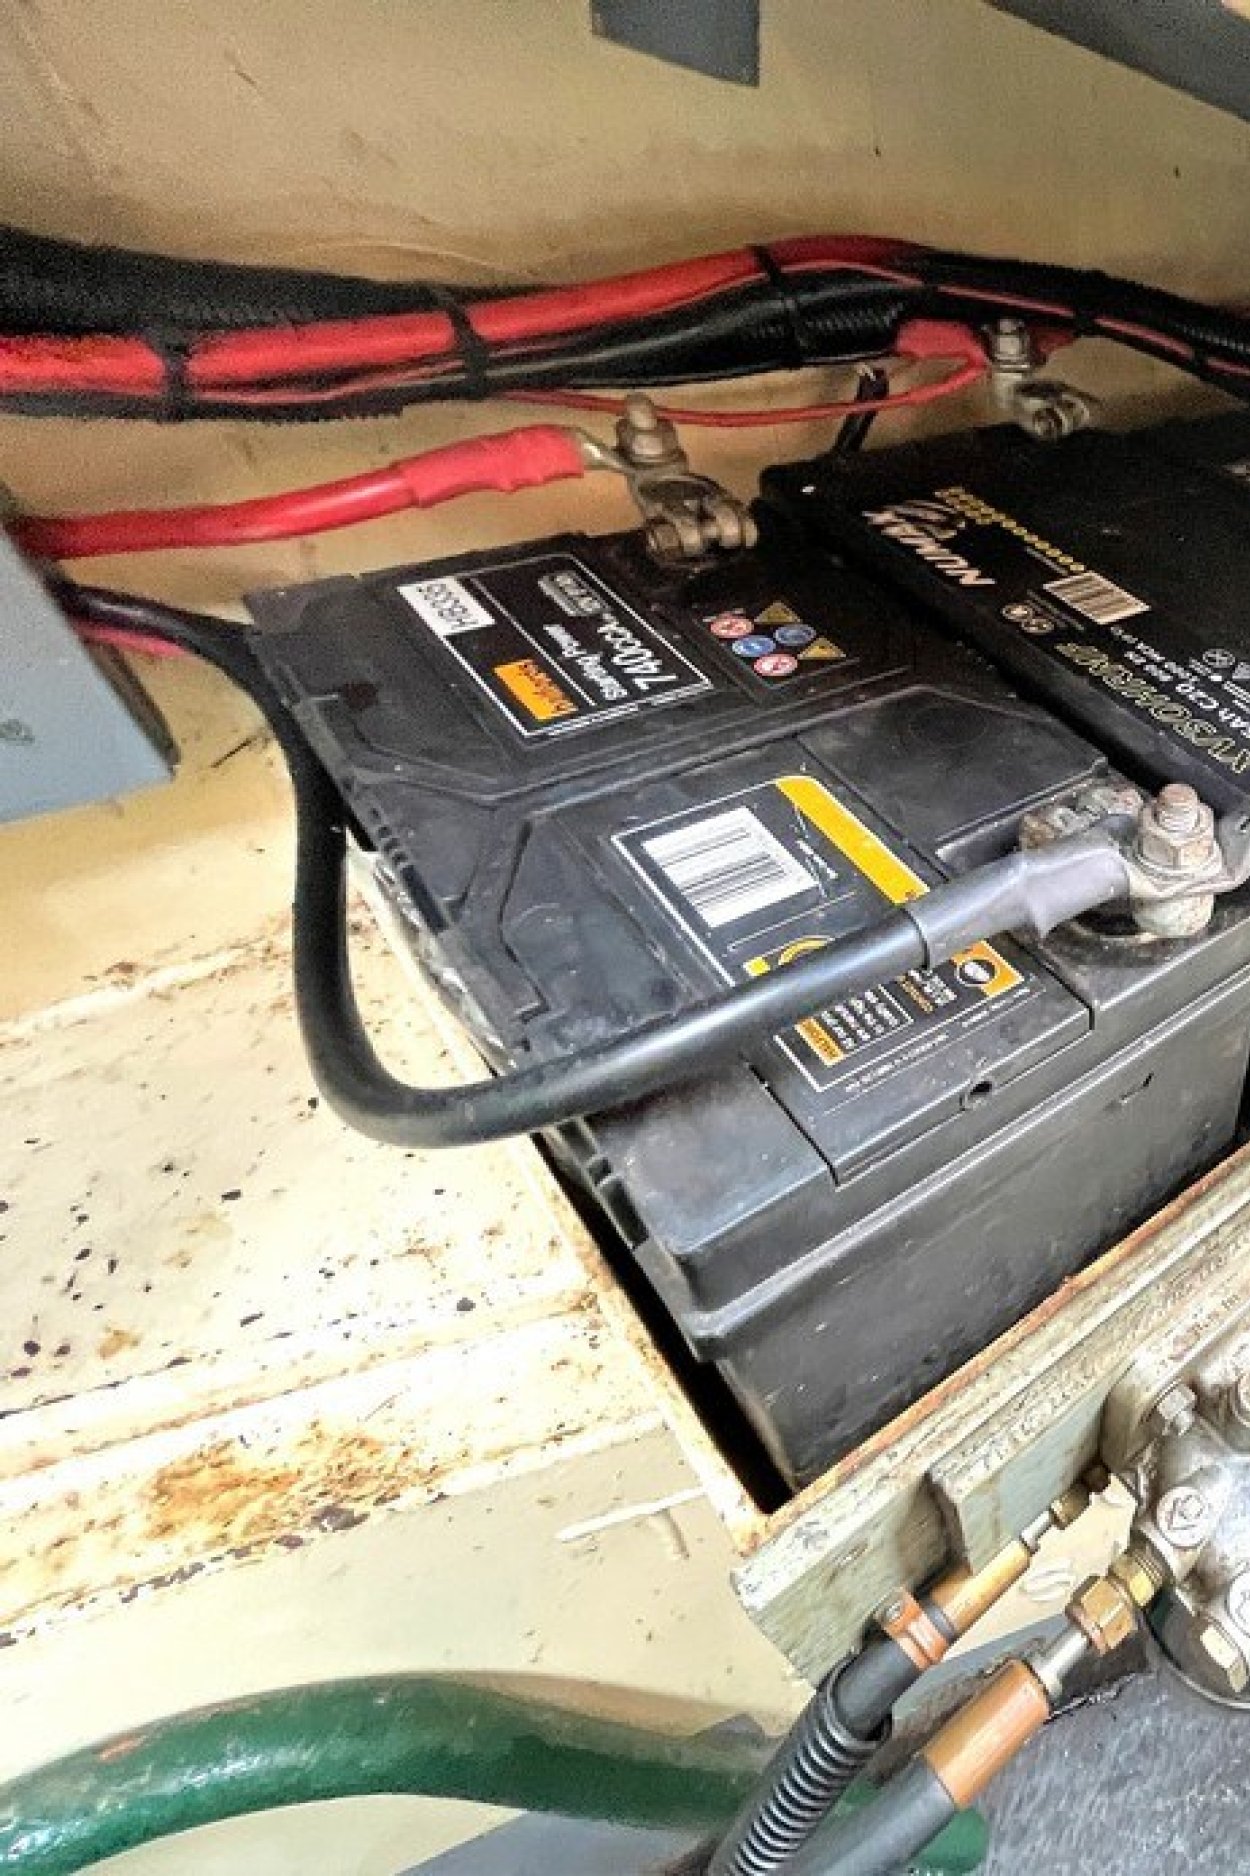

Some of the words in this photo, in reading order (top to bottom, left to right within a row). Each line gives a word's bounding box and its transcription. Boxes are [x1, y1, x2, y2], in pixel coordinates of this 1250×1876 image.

[861, 509, 996, 586] NUMAX
[543, 624, 587, 659] Power
[575, 653, 629, 701] Starting
